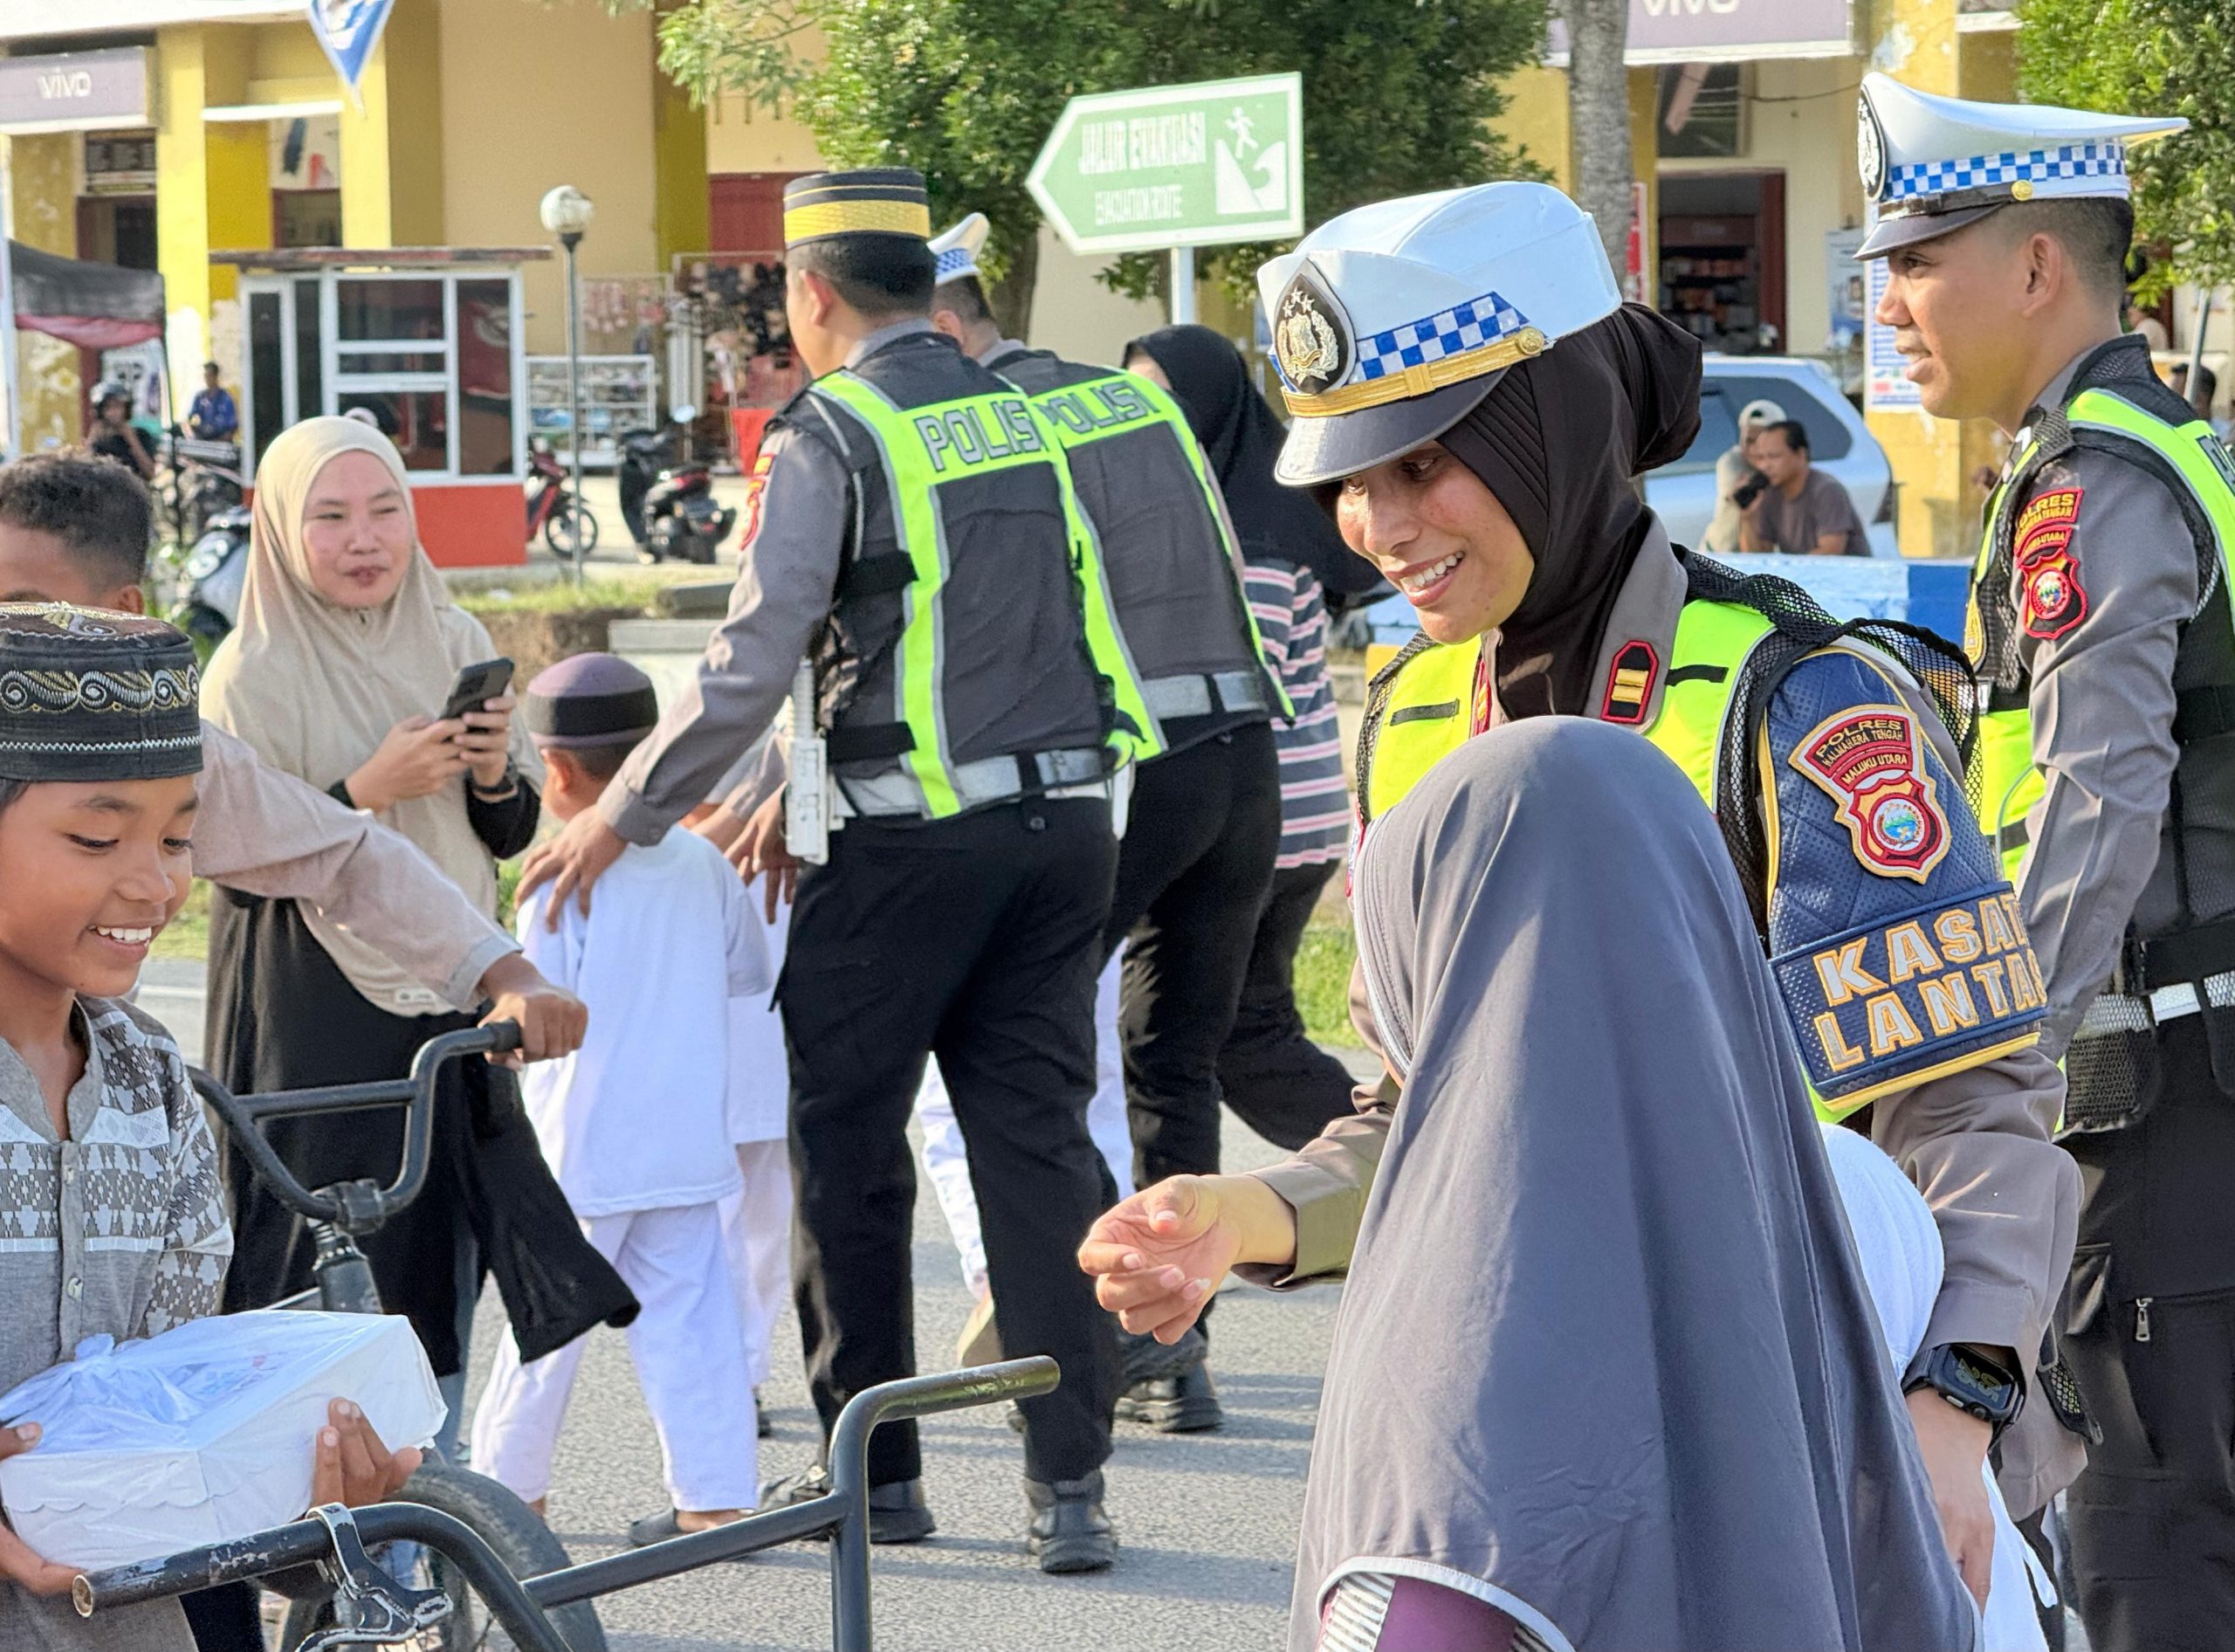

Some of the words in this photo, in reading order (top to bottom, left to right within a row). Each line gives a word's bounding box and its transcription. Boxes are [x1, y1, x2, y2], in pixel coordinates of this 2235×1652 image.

[2018, 494, 2074, 530] OLRES
[1816, 719, 1901, 758] POLRES
[1821, 731, 1870, 767] HALMAHERA
[1872, 728, 1903, 741] TENGAH
[1840, 756, 1877, 785] MALUKU
[1877, 754, 1908, 767] UTARA
